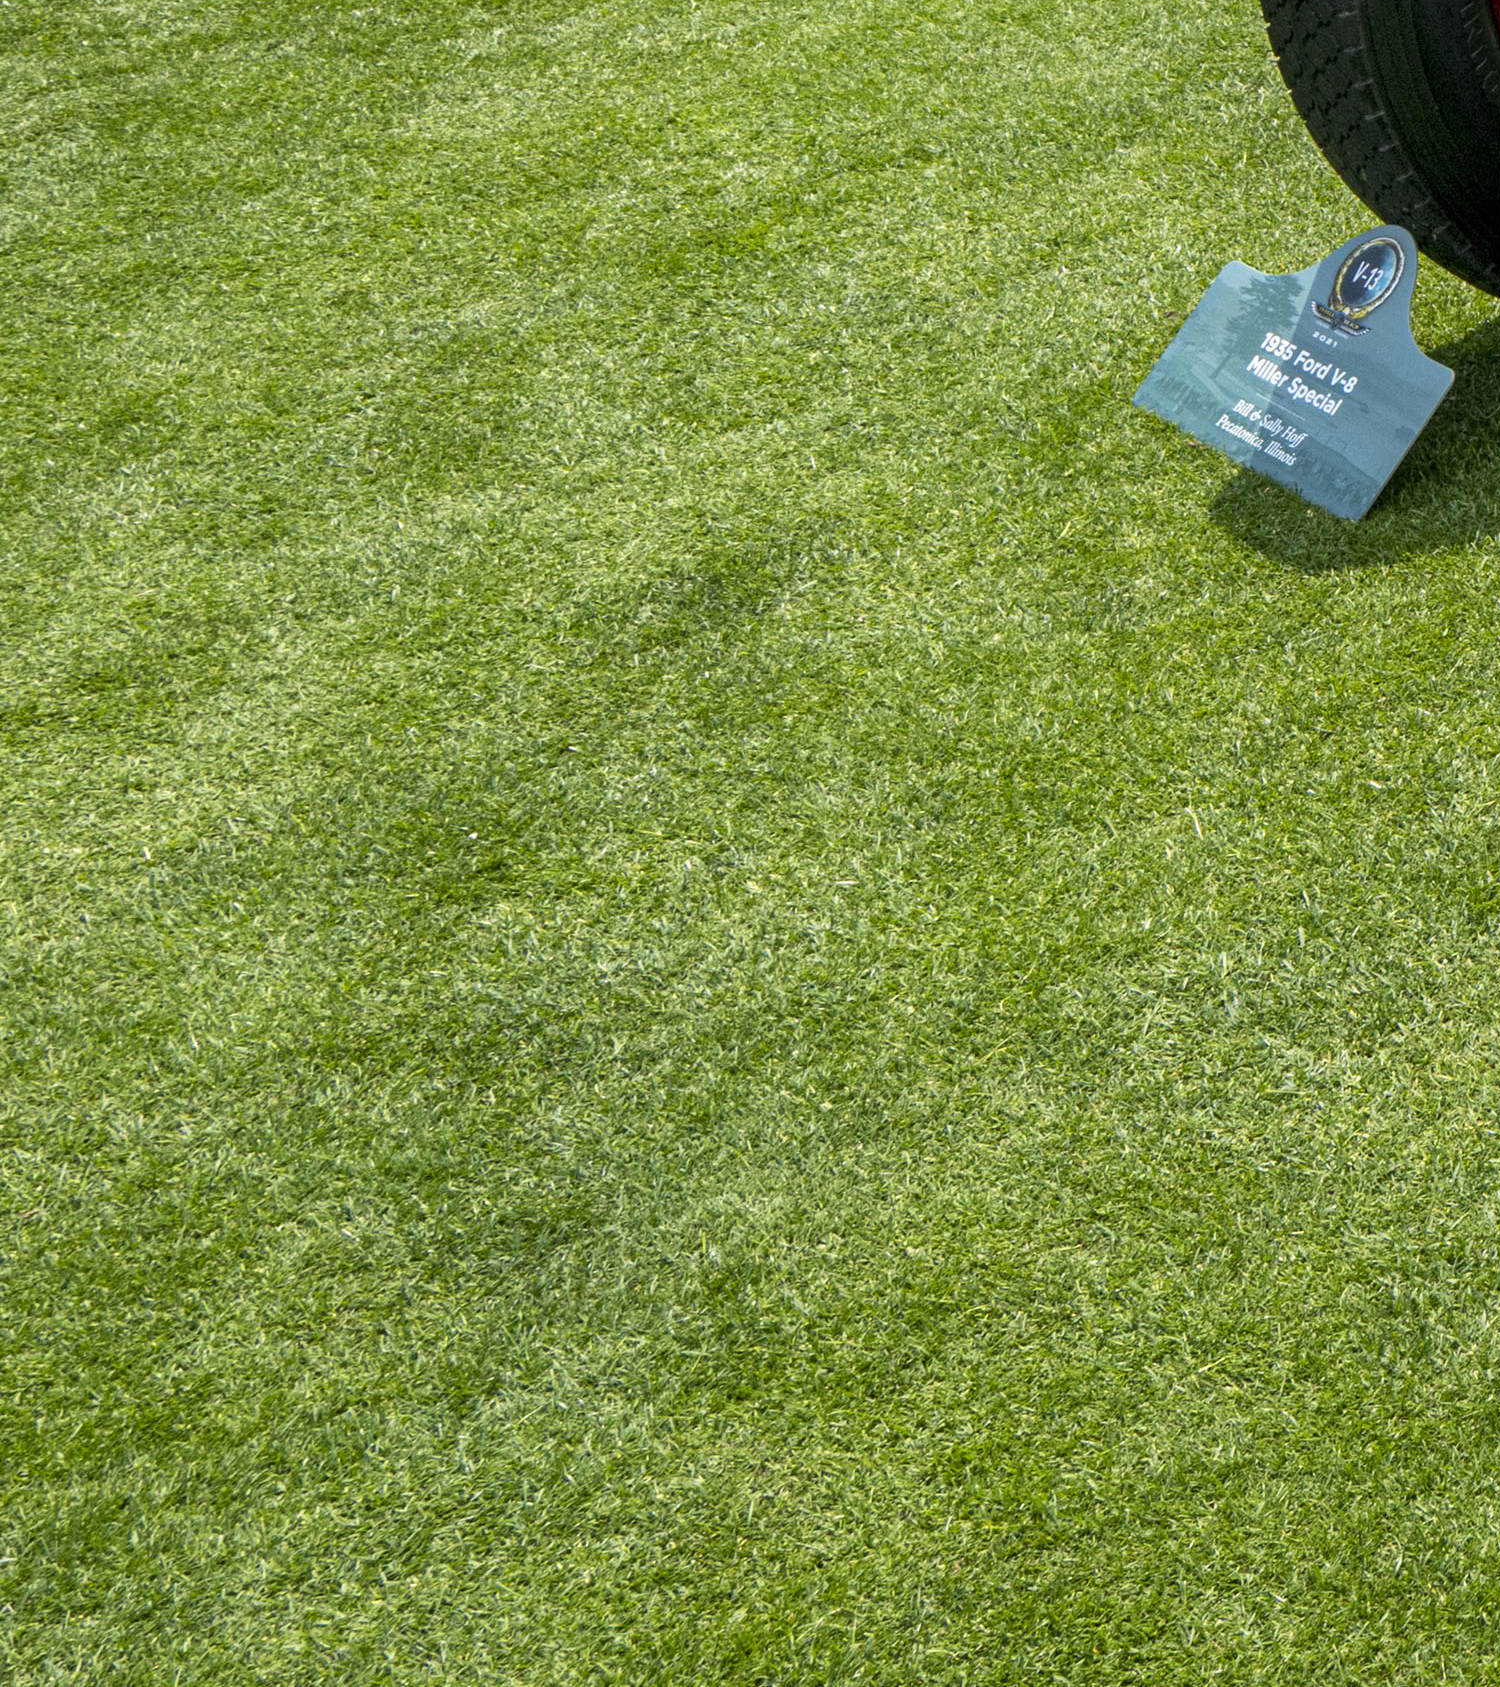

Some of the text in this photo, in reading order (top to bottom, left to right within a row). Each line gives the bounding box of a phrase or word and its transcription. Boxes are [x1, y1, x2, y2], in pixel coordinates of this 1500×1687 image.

[1352, 260, 1384, 291] V-13
[1260, 332, 1358, 394] 1935 Ford V-8
[1312, 331, 1339, 348] 2021
[1246, 355, 1344, 416] Miller Special
[1215, 414, 1297, 467] Pecatonica, Illinois
[1232, 399, 1309, 447] Bill & Sally Hoff
